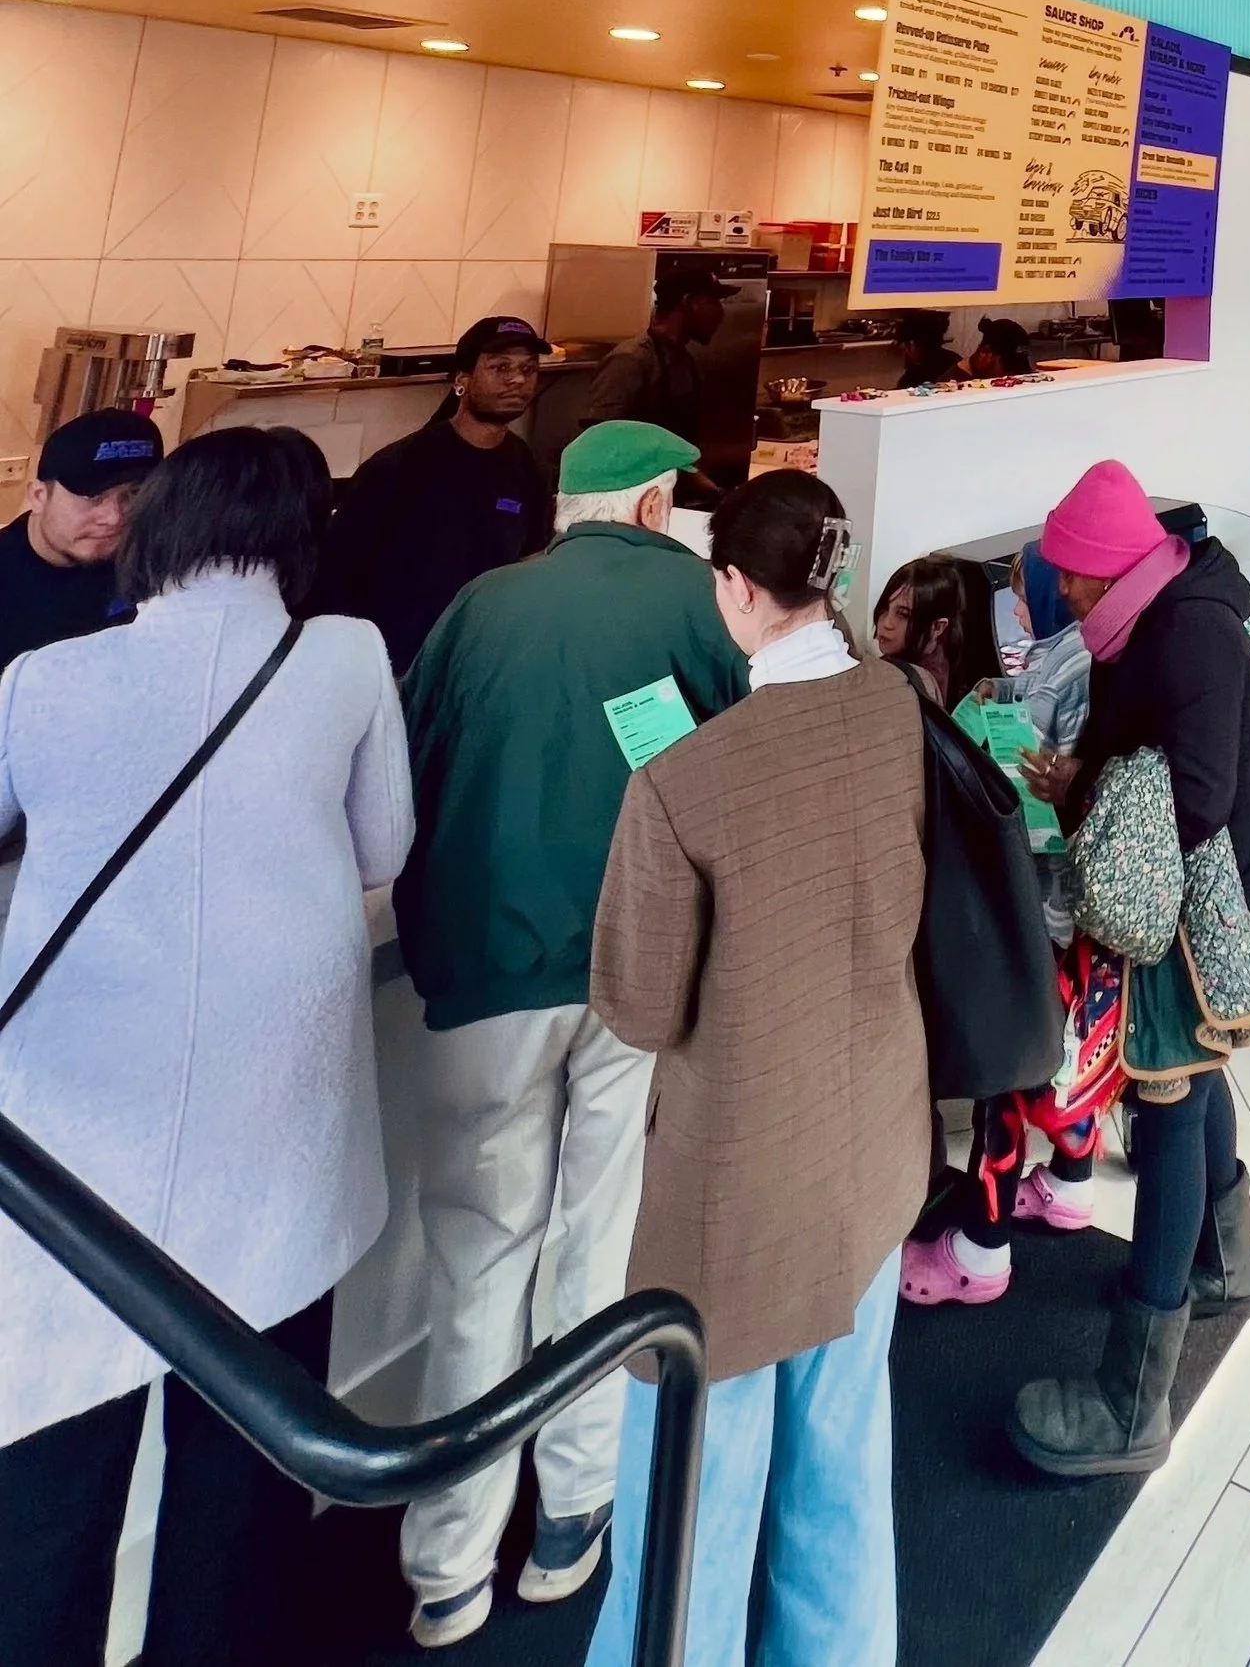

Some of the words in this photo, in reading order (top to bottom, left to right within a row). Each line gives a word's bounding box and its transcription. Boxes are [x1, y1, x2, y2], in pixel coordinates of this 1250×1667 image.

[1045, 5, 1078, 26] SAUCE
[1078, 15, 1104, 32] SHOP
[888, 86, 931, 105] Tricked-out
[932, 94, 955, 109] Wings
[879, 159, 893, 172] The
[894, 161, 909, 173] 4x4
[873, 207, 891, 218] Just
[892, 207, 905, 219] the
[906, 207, 923, 220] Bird
